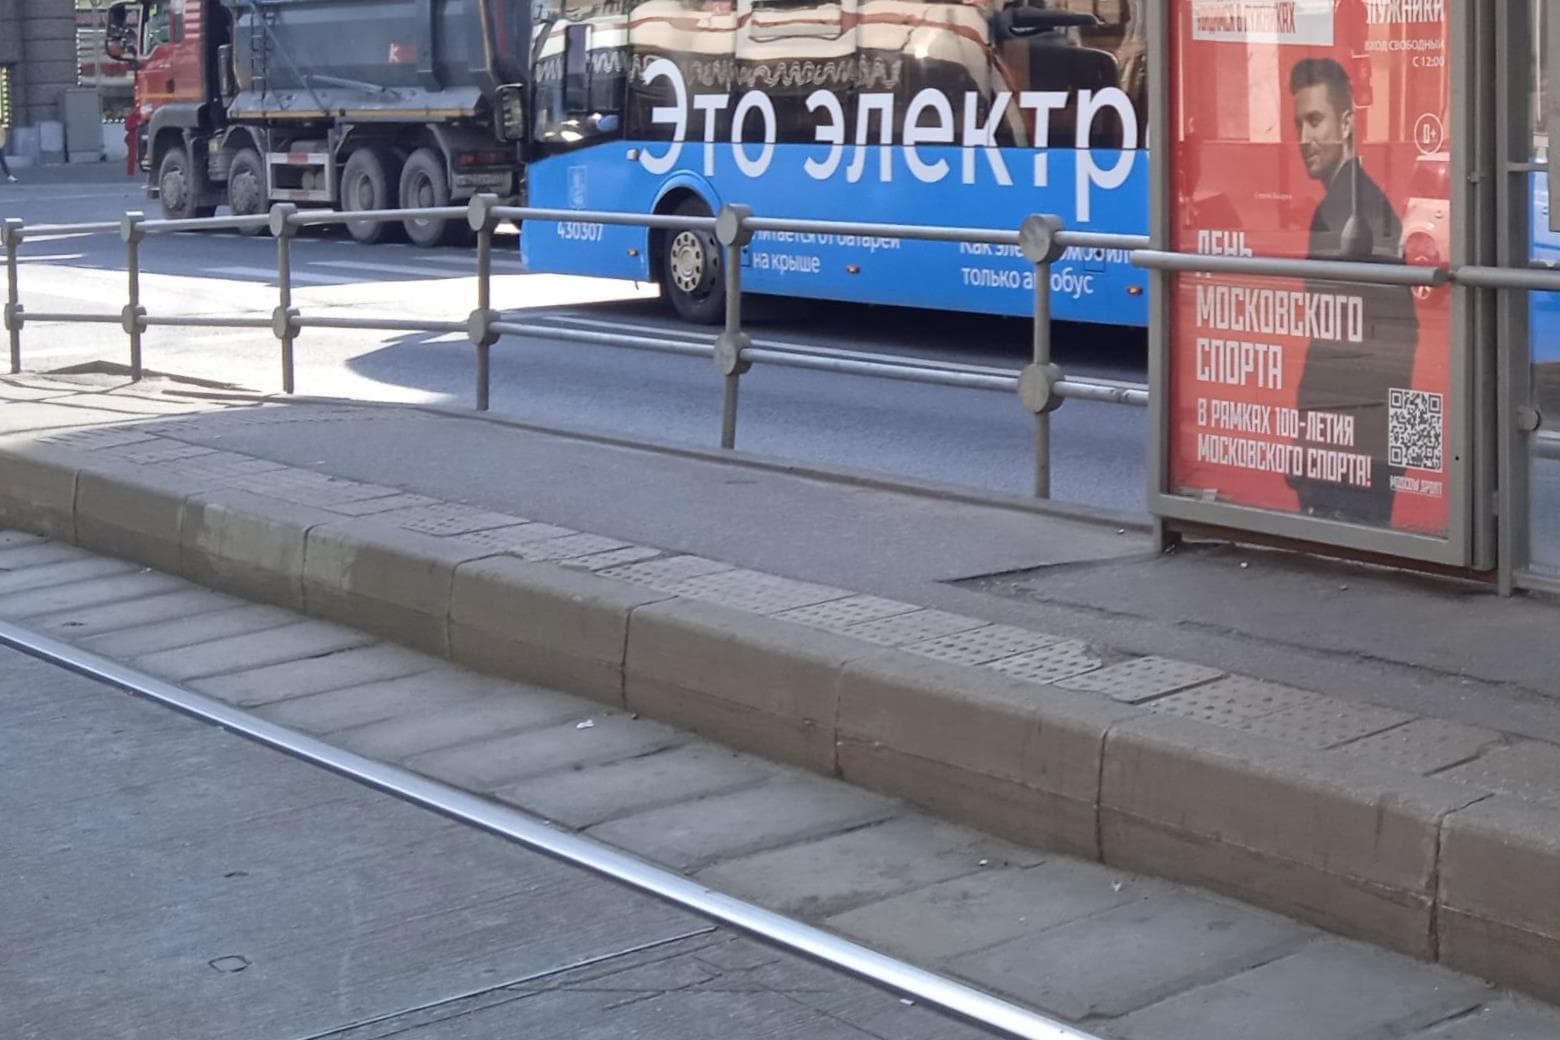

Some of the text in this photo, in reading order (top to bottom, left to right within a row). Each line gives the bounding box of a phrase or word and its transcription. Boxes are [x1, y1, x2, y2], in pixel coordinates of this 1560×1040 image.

[638, 59, 1150, 223] Это электр
[556, 220, 605, 241] 430307
[752, 252, 822, 276] на крыше
[961, 266, 1095, 300] только аобус
[1195, 284, 1363, 343] МОСКОВСКОГО
[1195, 337, 1283, 390] СПОРТА
[1197, 397, 1355, 447] В РАМКАХ 100-ЛЕТИЯ
[1197, 433, 1372, 487] МОСКОВСКОГО СПОРТА!
